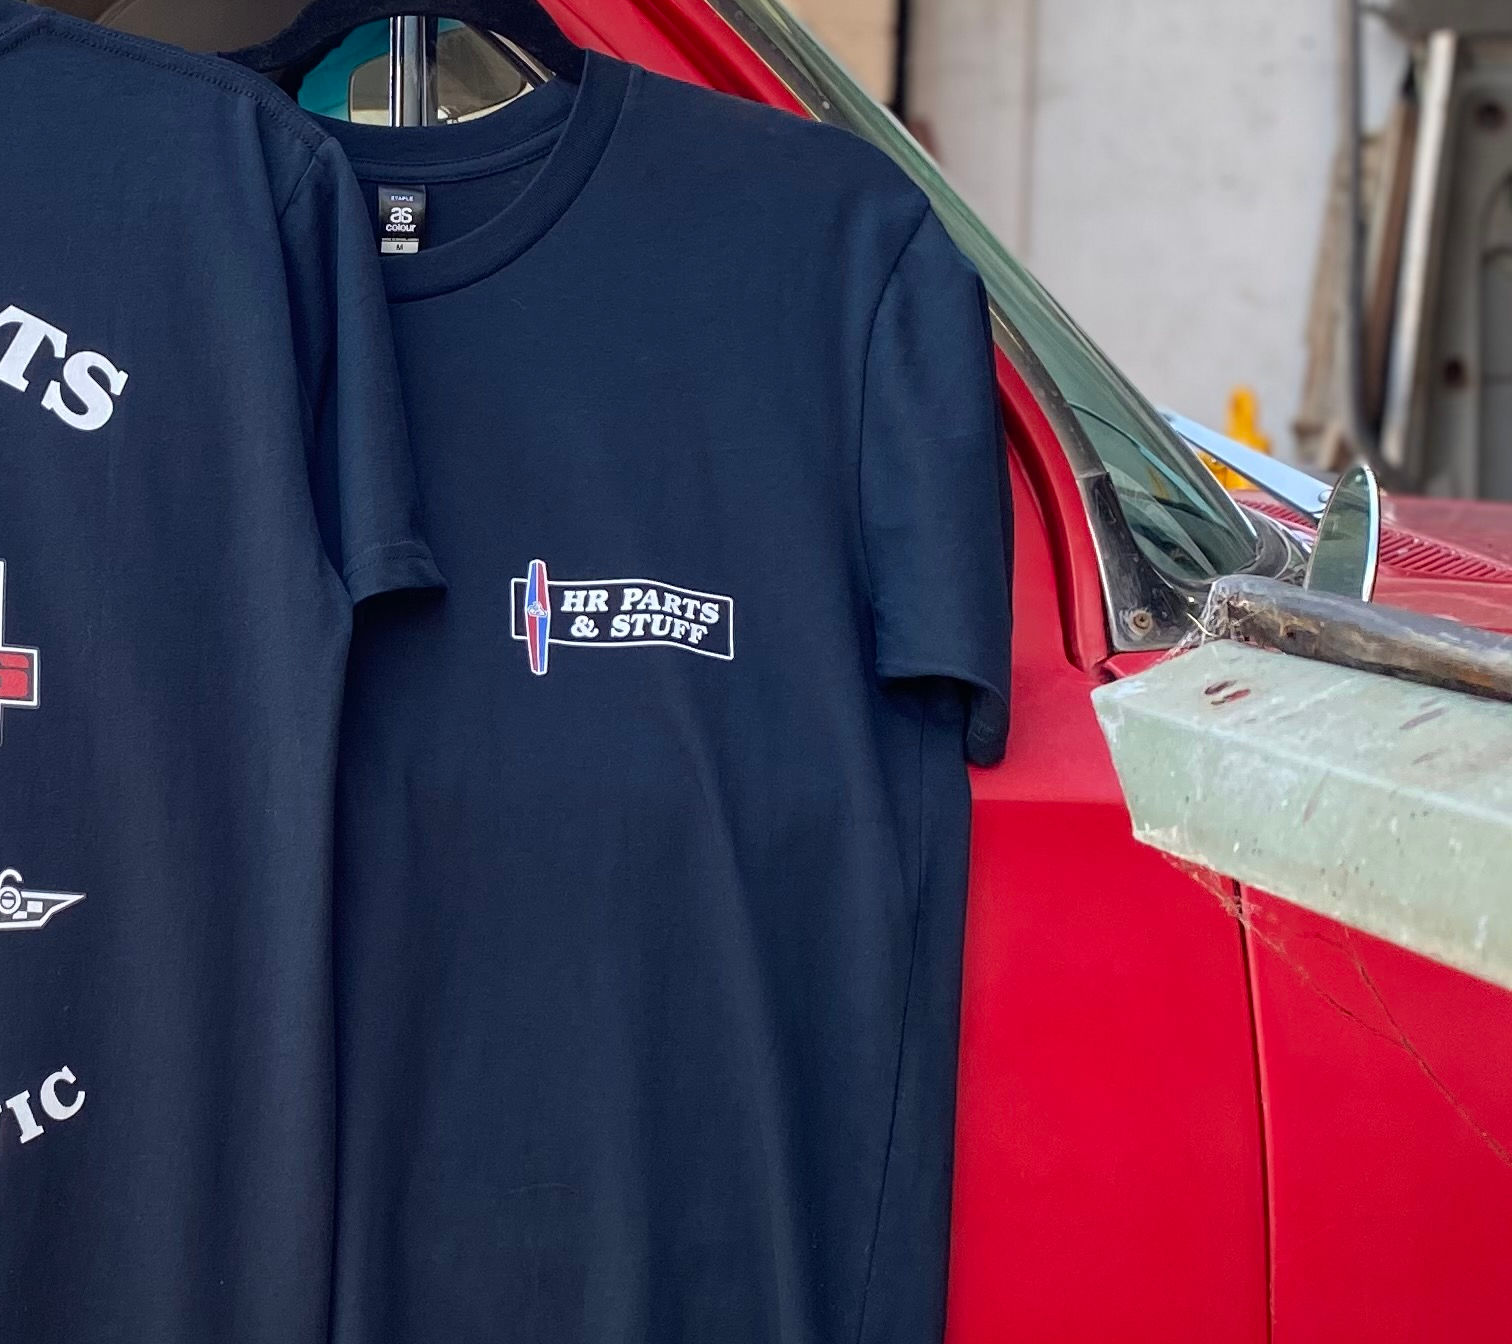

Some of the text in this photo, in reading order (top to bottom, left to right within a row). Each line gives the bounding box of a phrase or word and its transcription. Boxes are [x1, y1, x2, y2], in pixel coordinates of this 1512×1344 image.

[385, 223, 416, 232] colour
[559, 588, 721, 624] HR PARTS
[570, 613, 709, 645] & STUFF
